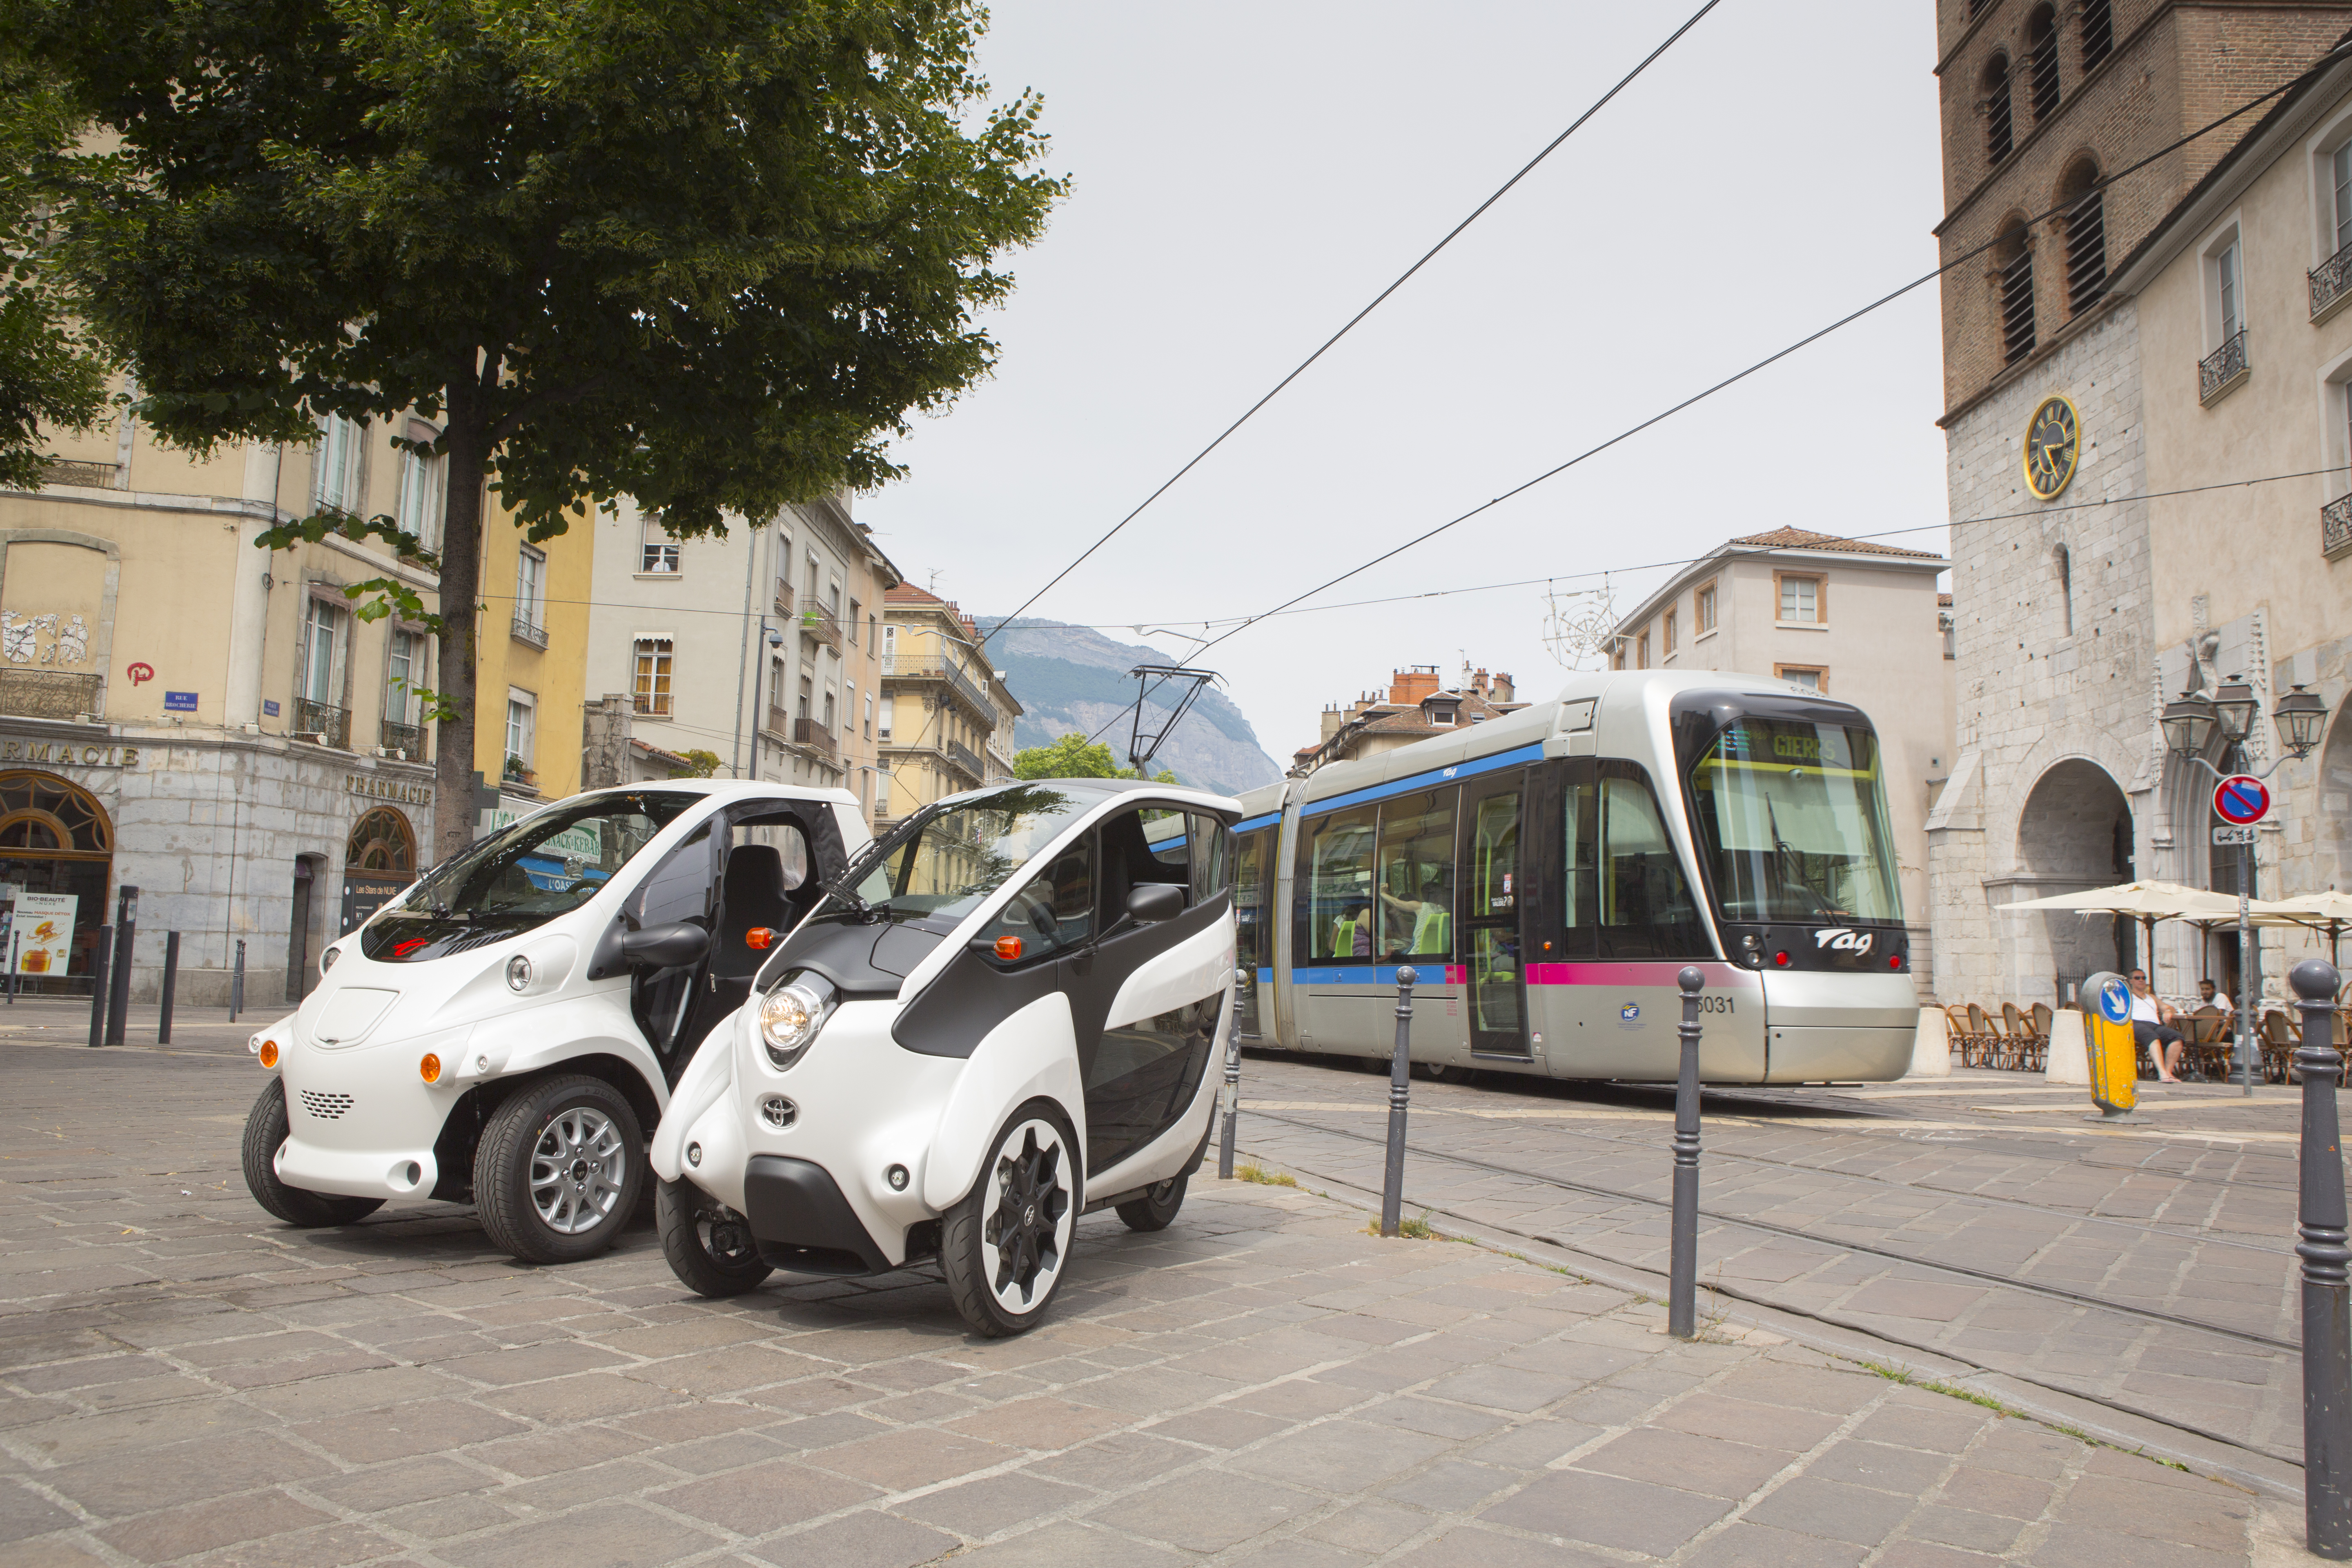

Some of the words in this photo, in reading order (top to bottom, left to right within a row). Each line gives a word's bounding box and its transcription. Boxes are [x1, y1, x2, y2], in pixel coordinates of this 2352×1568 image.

[345, 775, 432, 804] PHARMACIE
[574, 835, 600, 856] KEBAB
[356, 885, 365, 894] Les
[365, 885, 376, 894] Stars
[377, 886, 383, 894] de
[383, 886, 397, 895] NUXE
[548, 879, 575, 891] L'OAS
[1814, 929, 1873, 956] Tag
[1624, 1008, 1637, 1017] NF
